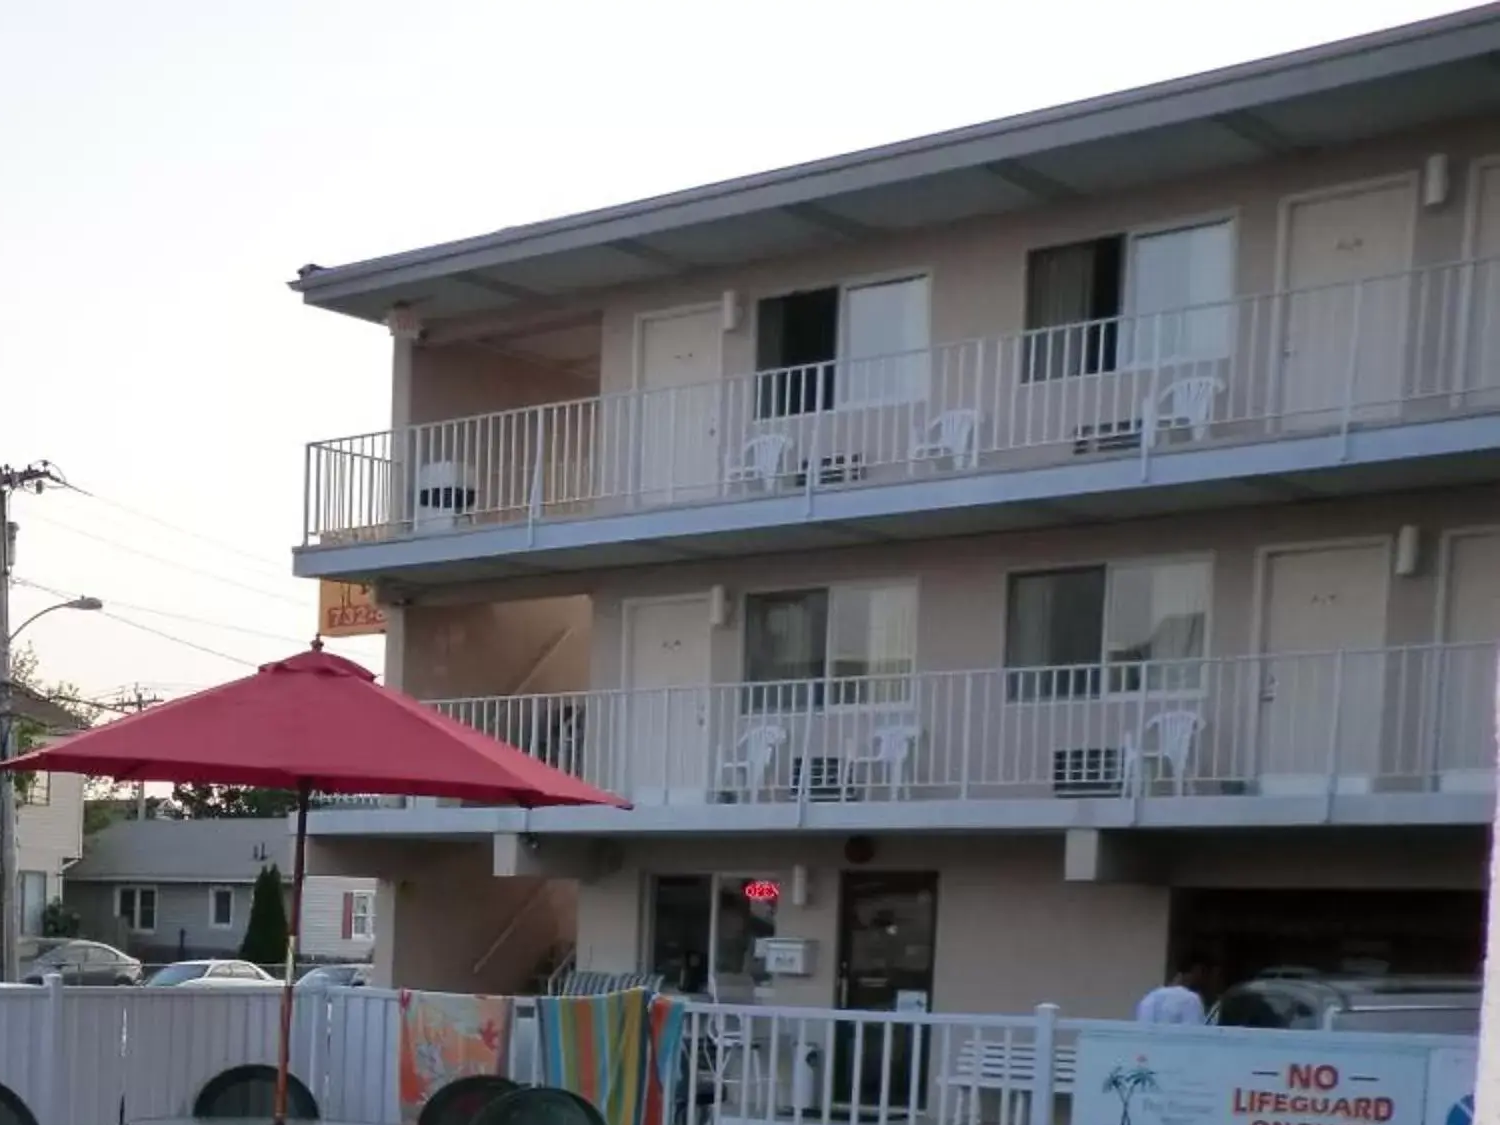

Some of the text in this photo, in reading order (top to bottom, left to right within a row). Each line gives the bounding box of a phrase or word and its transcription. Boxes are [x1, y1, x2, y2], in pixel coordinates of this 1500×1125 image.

[745, 882, 779, 899] OPEN
[1288, 1063, 1339, 1090] NO
[1233, 1087, 1394, 1122] LIFEGUARD
